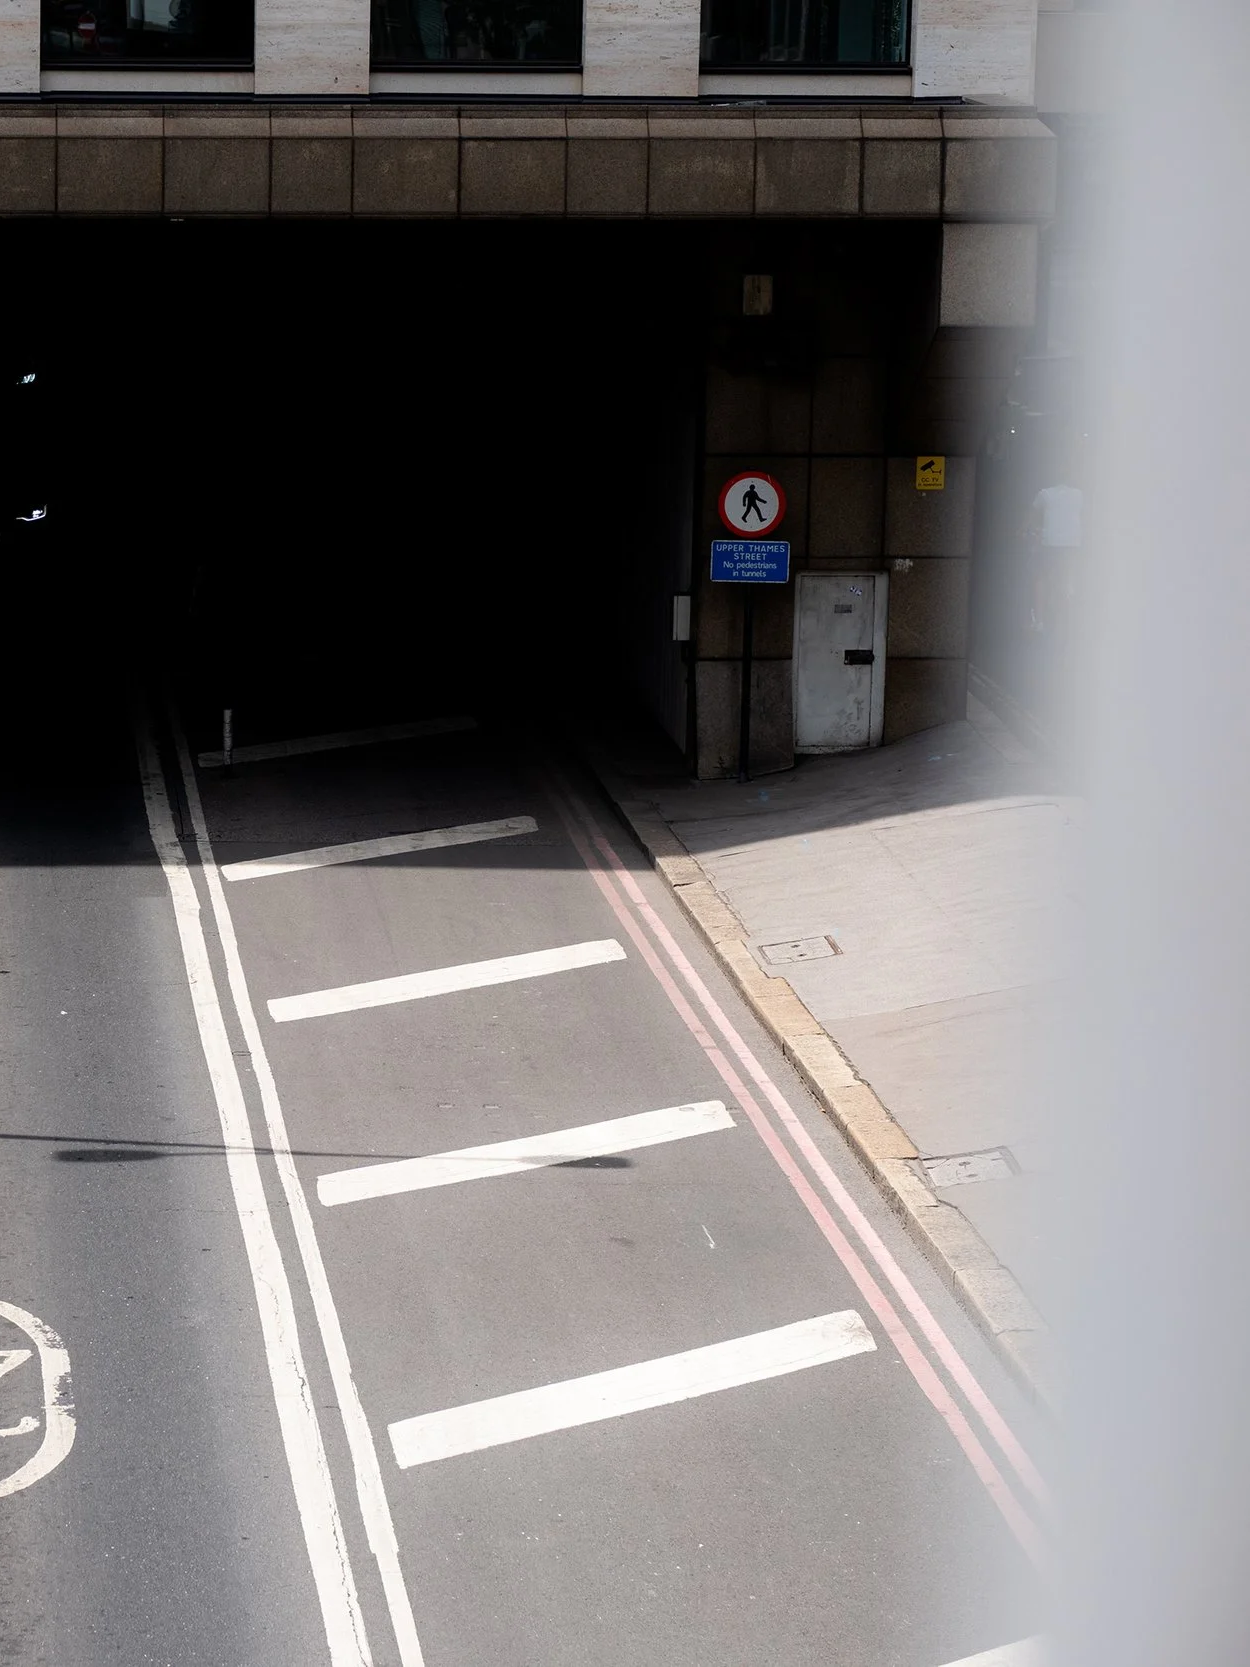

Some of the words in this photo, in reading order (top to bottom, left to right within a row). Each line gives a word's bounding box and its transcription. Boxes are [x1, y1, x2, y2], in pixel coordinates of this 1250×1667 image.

[716, 544, 744, 552] UPPER
[749, 544, 786, 553] THAMES
[733, 552, 767, 561] STREET
[723, 561, 734, 569] No
[736, 561, 777, 570] pedestrians
[732, 569, 739, 577] in
[742, 570, 767, 578] tunnels
